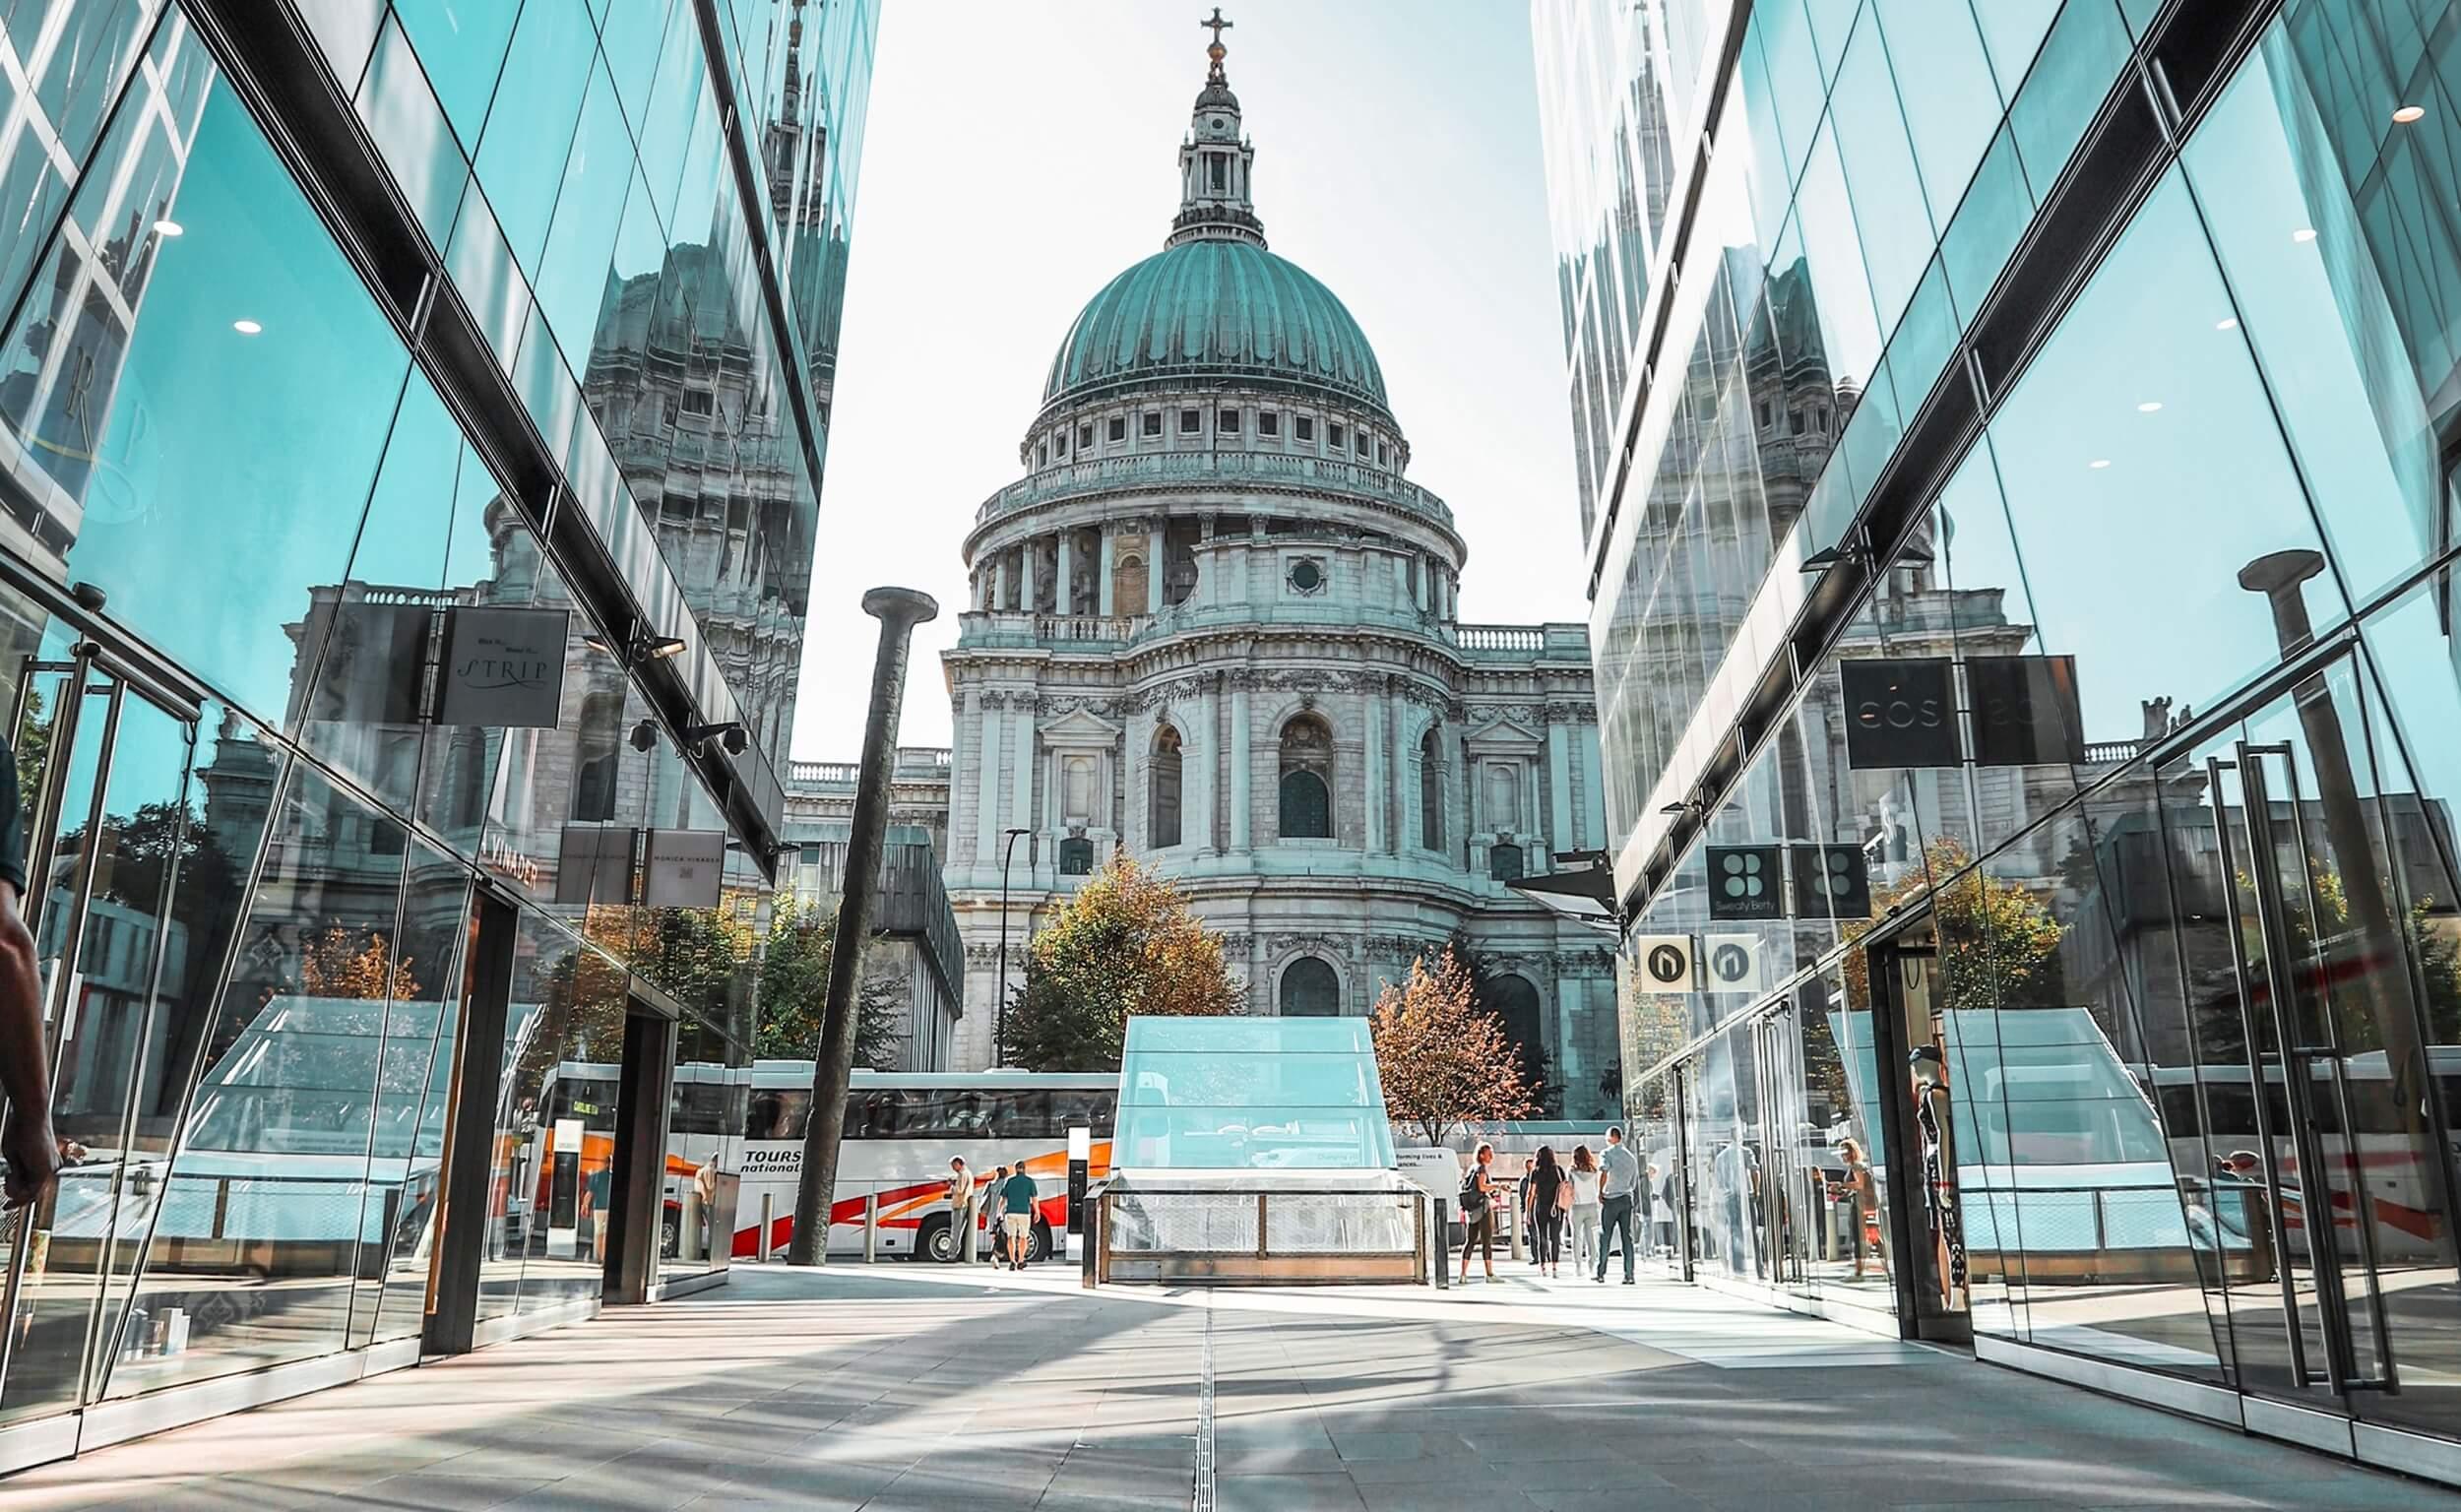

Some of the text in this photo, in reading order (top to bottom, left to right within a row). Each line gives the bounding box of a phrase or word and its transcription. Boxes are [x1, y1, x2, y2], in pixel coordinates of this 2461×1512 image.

[457, 659, 548, 689] STRIP
[1859, 700, 1941, 728] COS
[492, 833, 537, 891] VINADER
[739, 1163, 799, 1172] national
[745, 1151, 802, 1163] TOURS
